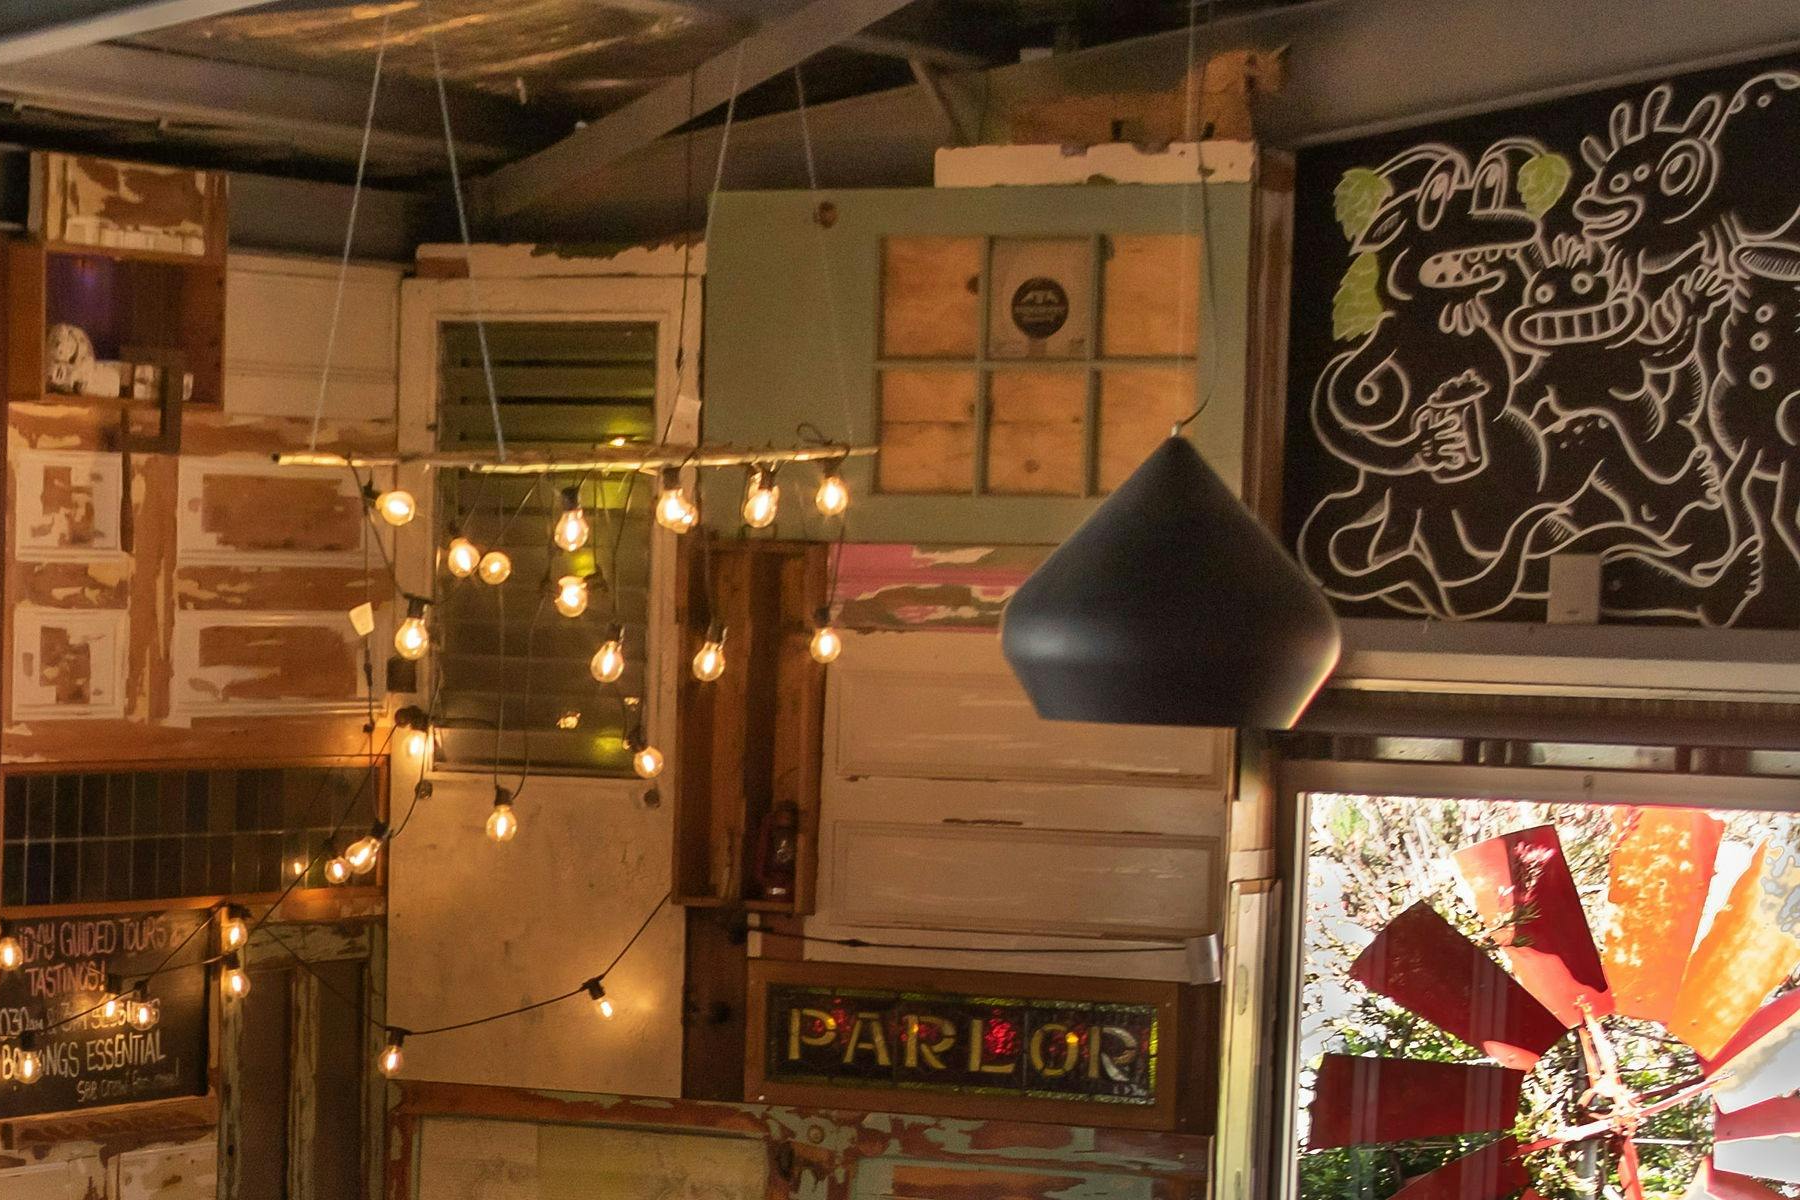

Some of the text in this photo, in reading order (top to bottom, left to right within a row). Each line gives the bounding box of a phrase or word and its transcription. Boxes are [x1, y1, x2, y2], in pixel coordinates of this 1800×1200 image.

[60, 919, 117, 958] GUIDED
[121, 916, 168, 952] TOURS
[85, 1029, 167, 1072] ESSENTIAL
[787, 1006, 1139, 1083] PARLOR
